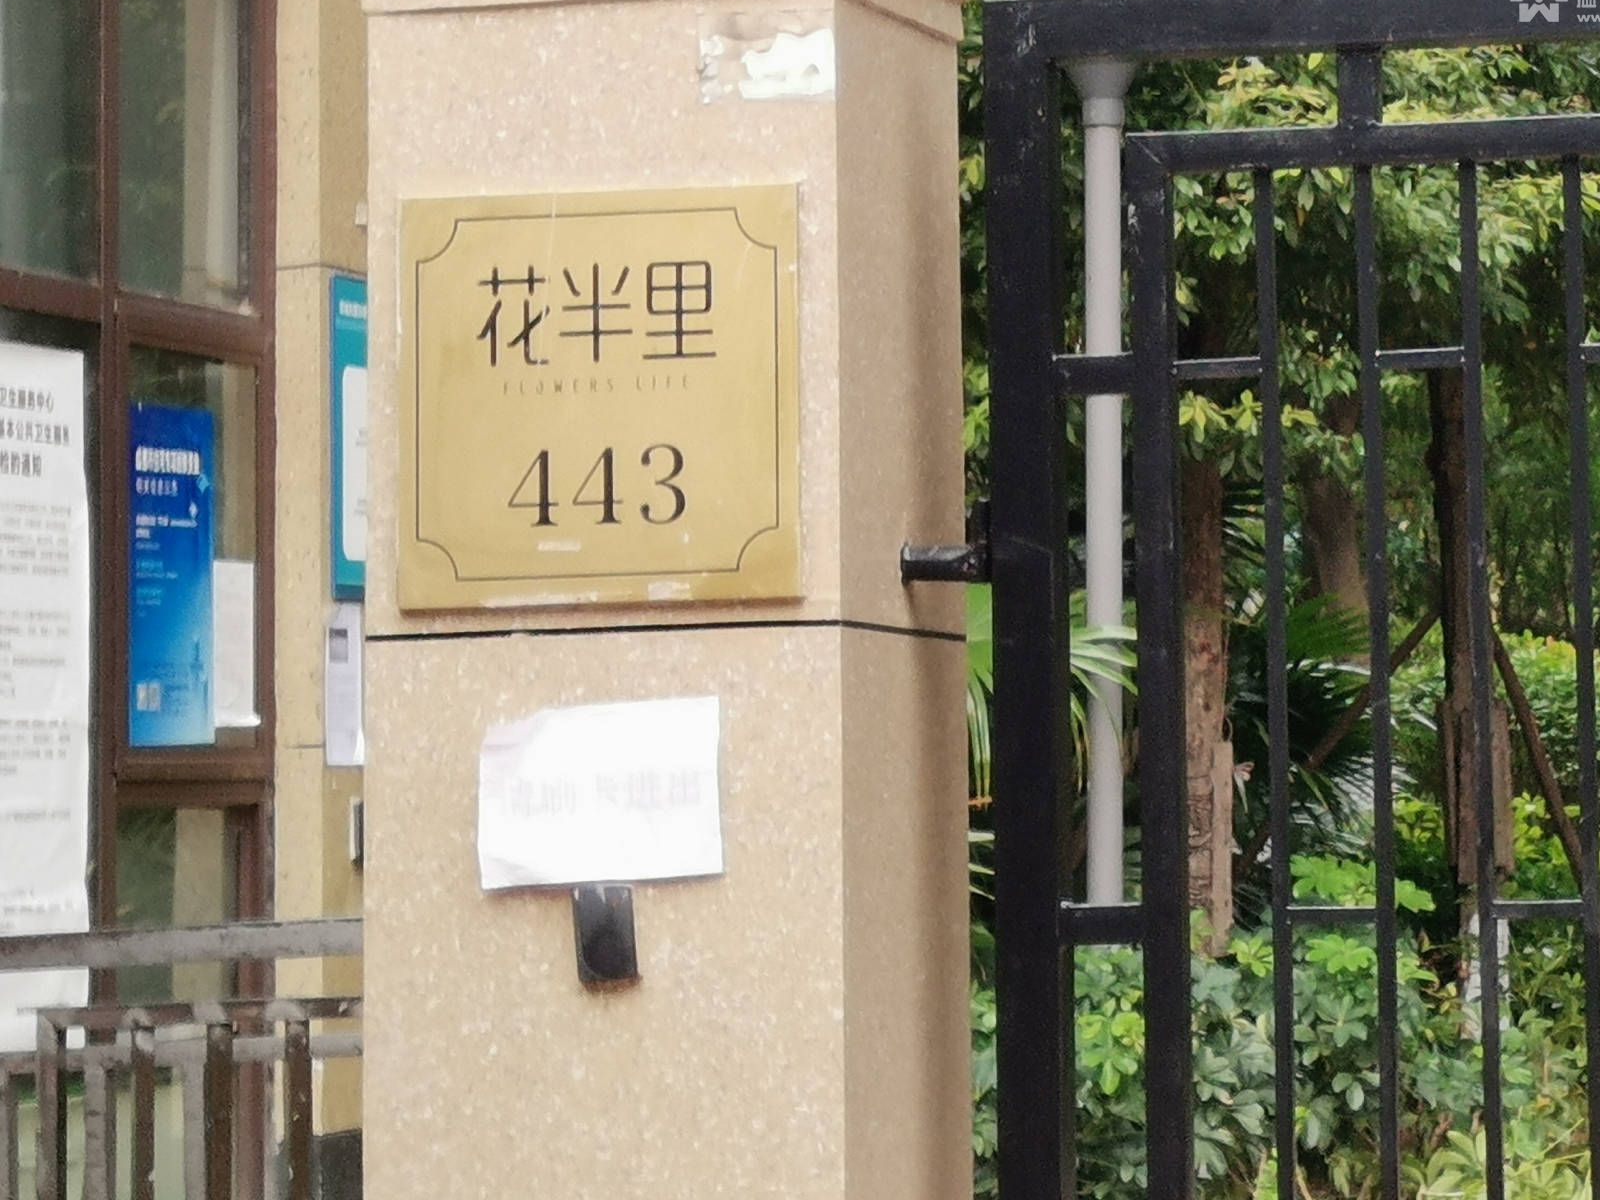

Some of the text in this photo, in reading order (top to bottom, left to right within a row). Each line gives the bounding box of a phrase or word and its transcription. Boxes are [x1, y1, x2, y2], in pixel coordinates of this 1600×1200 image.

[476, 260, 717, 368] 花半里
[503, 374, 689, 396] FLOWERS LIFE
[507, 443, 687, 528] 443
